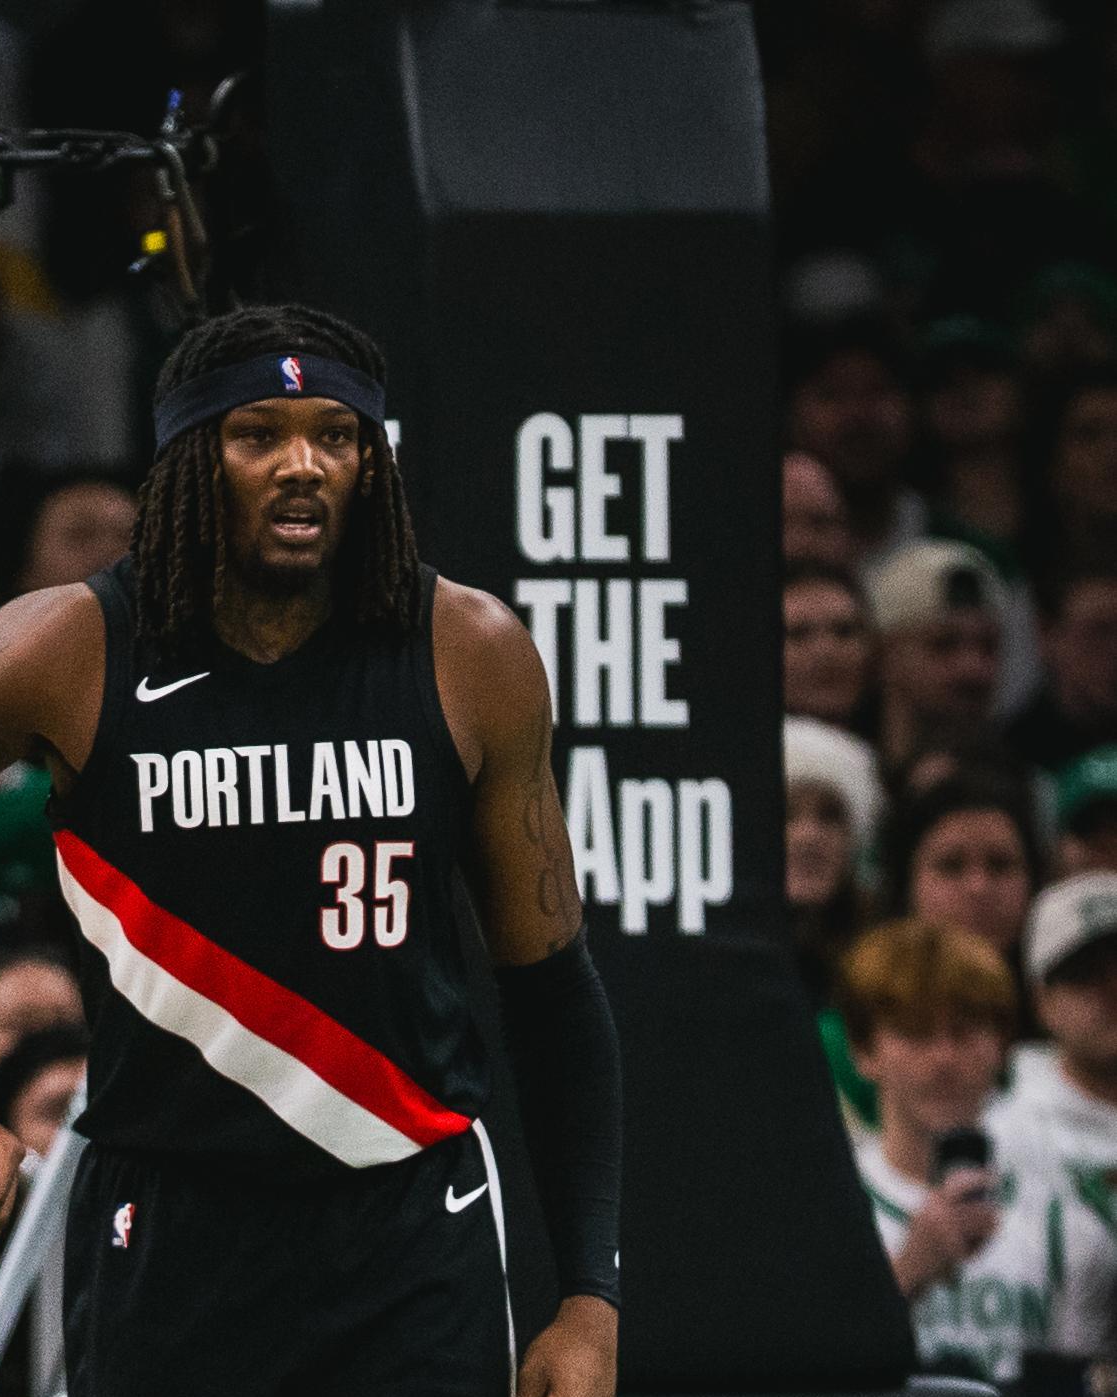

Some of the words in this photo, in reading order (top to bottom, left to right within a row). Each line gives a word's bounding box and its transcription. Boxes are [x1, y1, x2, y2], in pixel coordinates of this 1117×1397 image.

[515, 411, 685, 563] GET
[513, 578, 690, 729] THE
[129, 739, 416, 833] PORTLAND
[565, 745, 734, 936] App
[319, 839, 415, 952] 35
